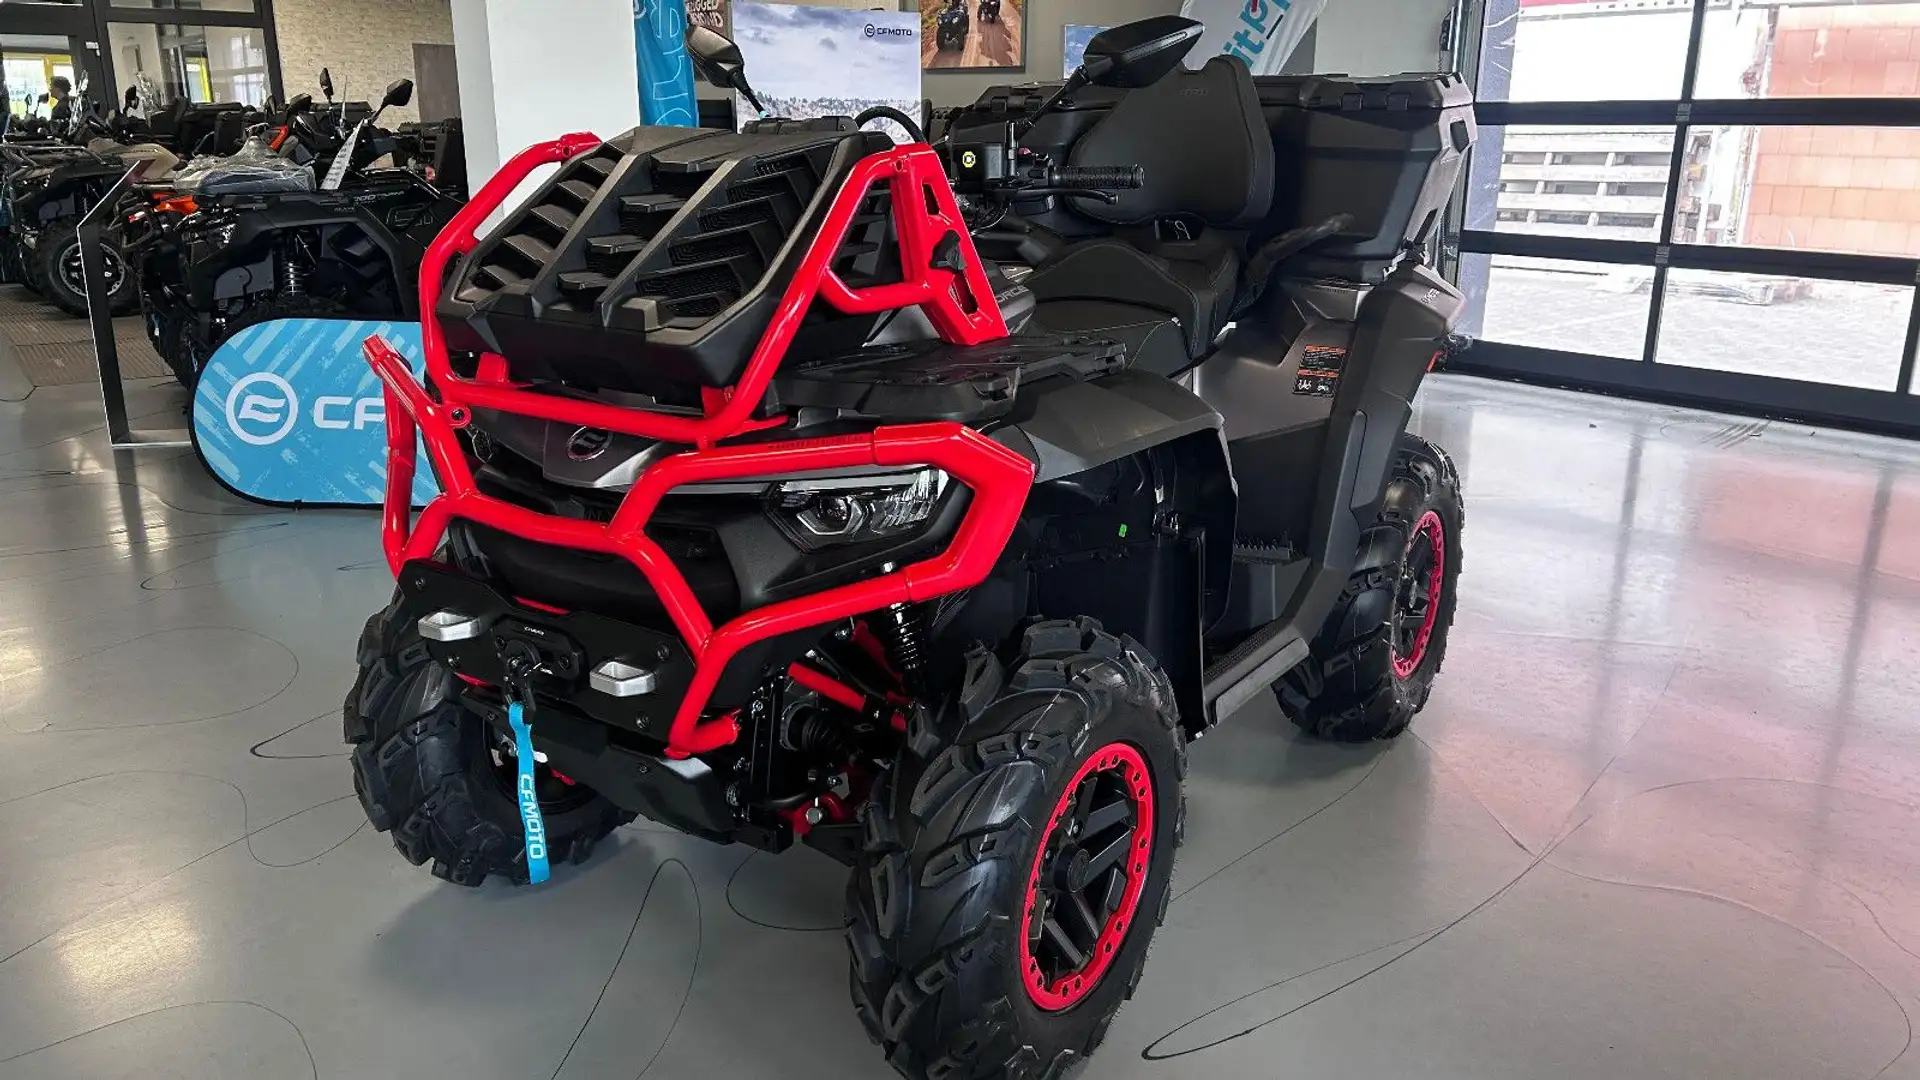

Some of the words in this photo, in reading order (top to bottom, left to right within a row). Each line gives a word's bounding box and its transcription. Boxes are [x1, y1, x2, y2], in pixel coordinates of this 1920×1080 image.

[876, 27, 912, 36] CFMOTO
[995, 284, 1030, 304] ORCE
[313, 395, 386, 430] CF
[520, 773, 545, 860] CFMOTO
